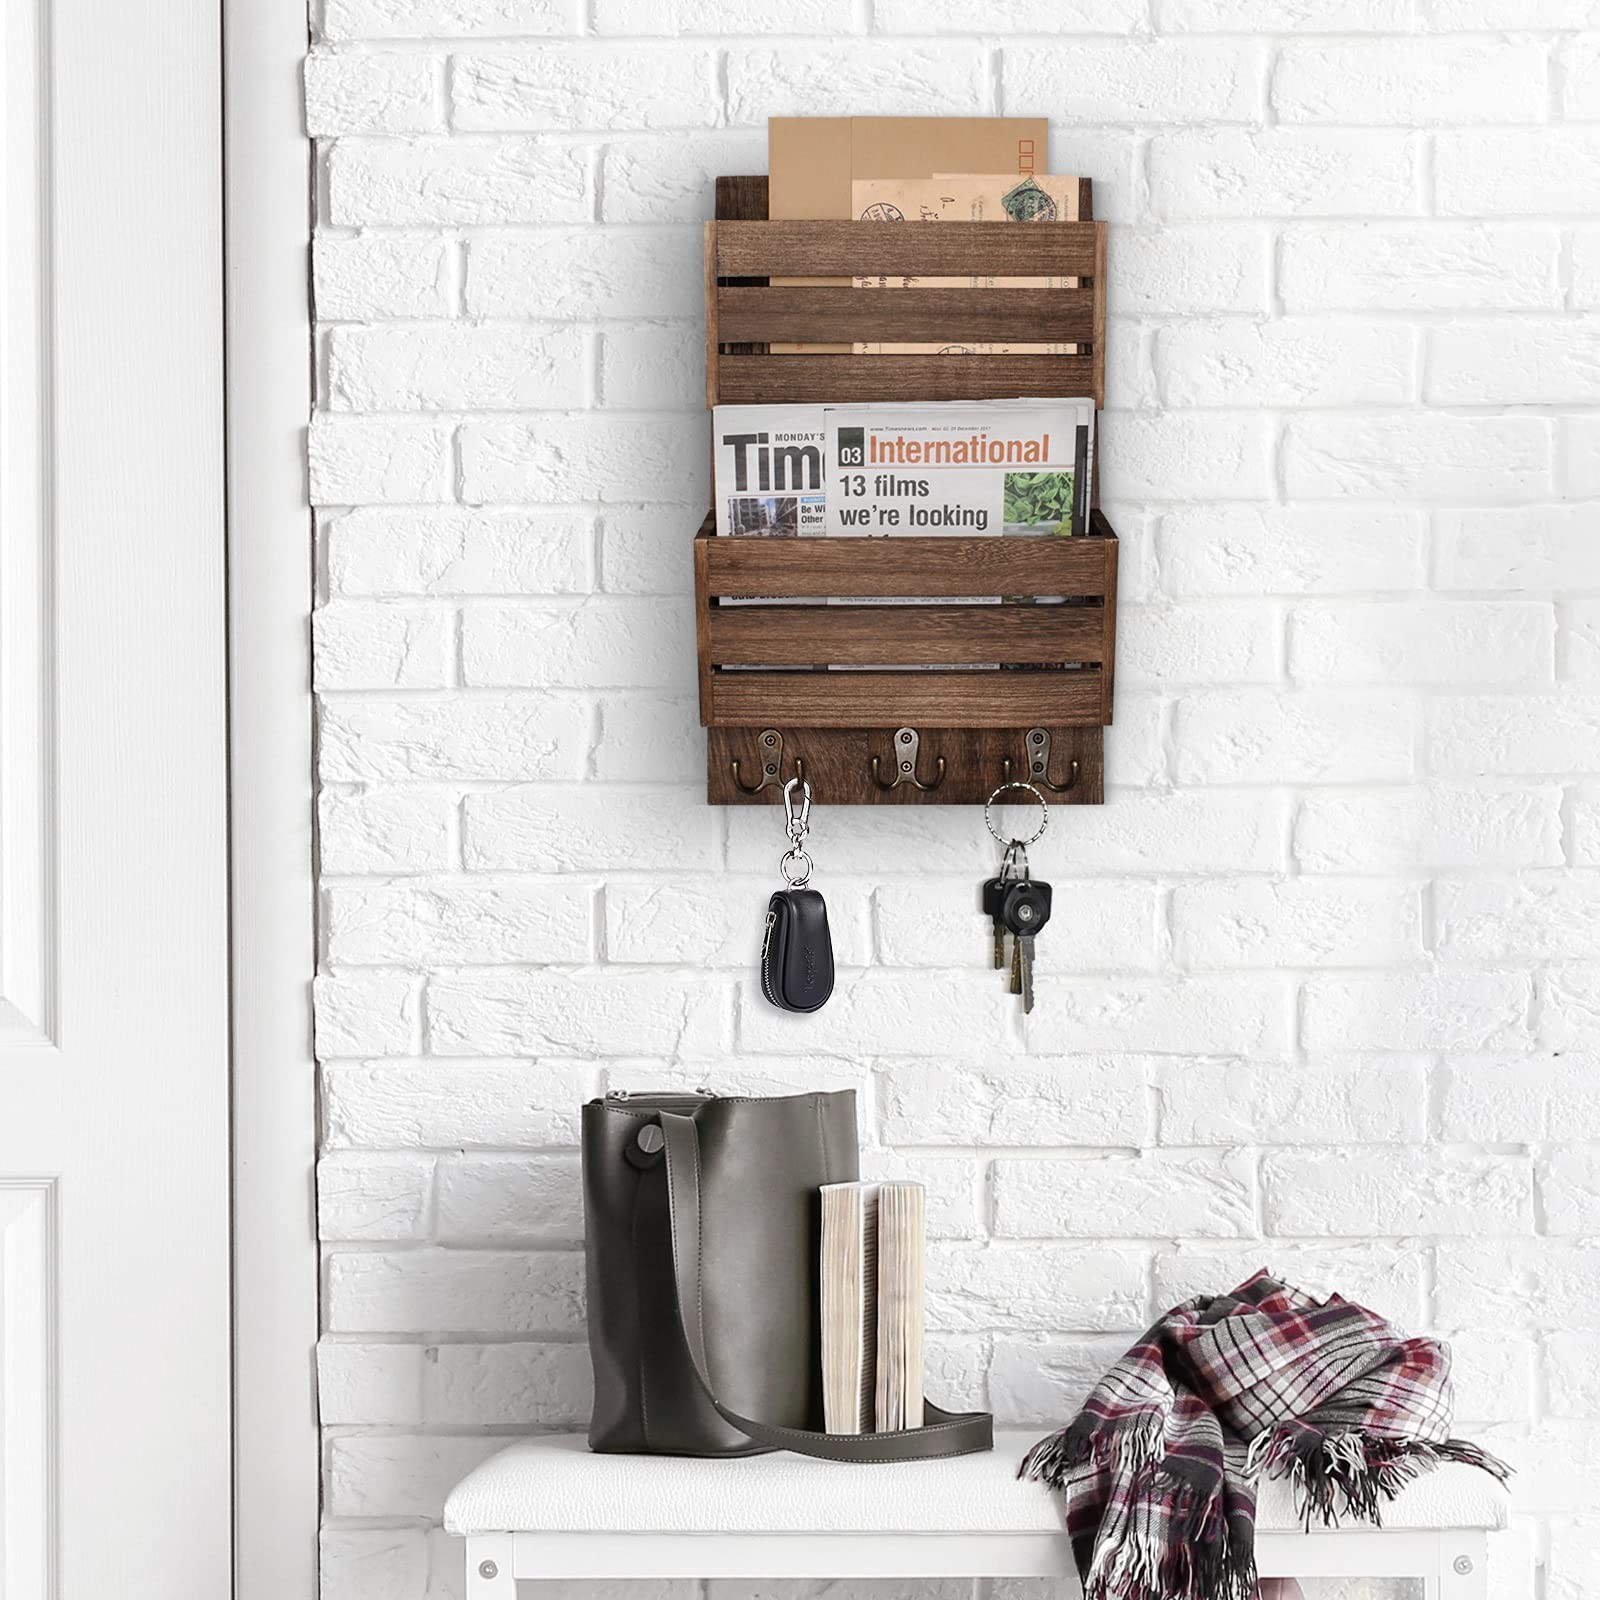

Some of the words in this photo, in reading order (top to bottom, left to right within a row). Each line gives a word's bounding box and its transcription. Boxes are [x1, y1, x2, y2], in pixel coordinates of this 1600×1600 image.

[775, 433, 825, 442] MONDAY'S
[841, 447, 861, 464] 03
[870, 434, 1049, 464] International
[723, 432, 825, 491] Tim
[839, 475, 867, 497] 13
[874, 474, 930, 497] films
[801, 505, 812, 514] Be
[801, 515, 824, 524] Other
[839, 505, 900, 526] we're
[909, 504, 988, 530] looking
